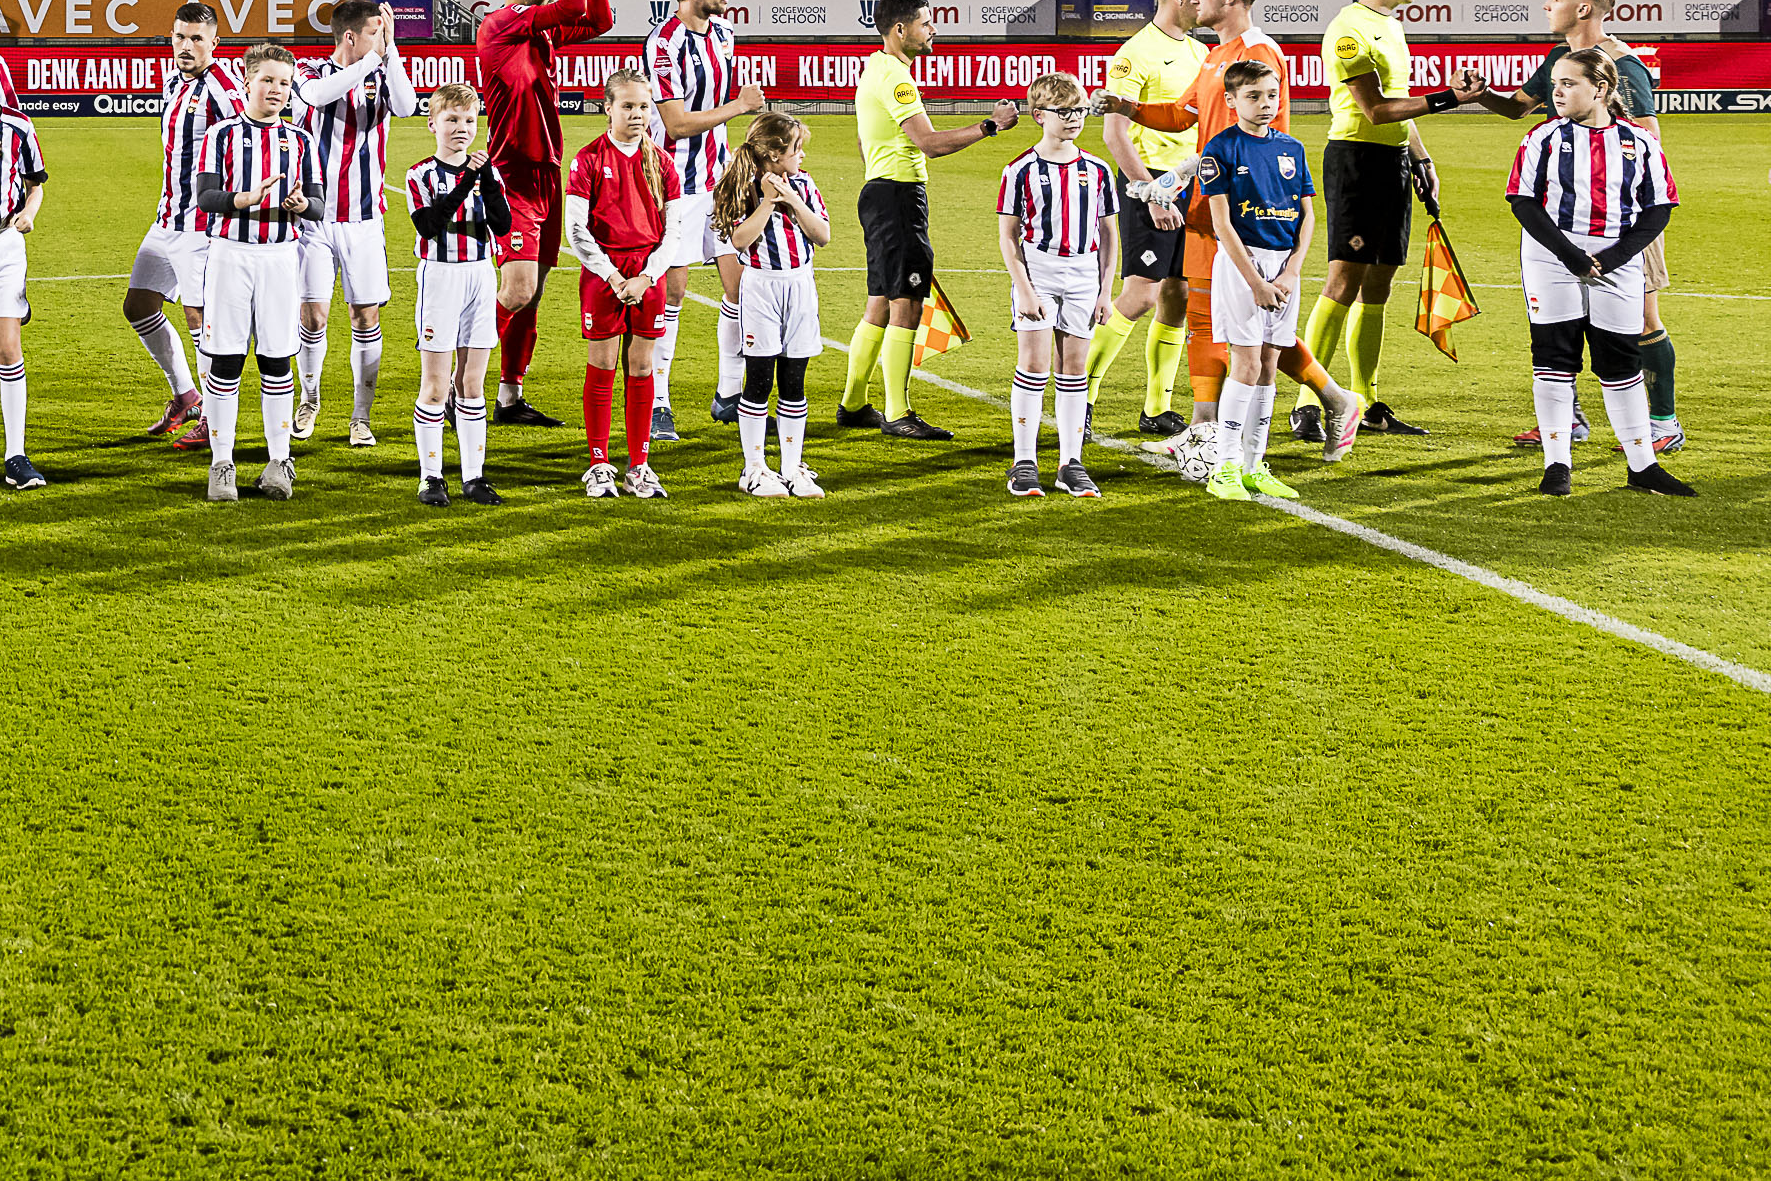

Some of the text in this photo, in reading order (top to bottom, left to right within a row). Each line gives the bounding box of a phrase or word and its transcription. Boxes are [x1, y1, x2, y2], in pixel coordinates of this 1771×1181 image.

[771, 5, 826, 13] ONGEWOON
[981, 5, 1036, 13] ONGEWOON
[1474, 4, 1529, 12] ONGEWOON
[1685, 3, 1740, 11] ONGEWOON
[771, 13, 826, 24] SCHOON
[981, 13, 1036, 24] SCHOON
[1093, 11, 1146, 21] Q-SIGNING.NL
[1264, 12, 1319, 23] SCHOON
[1474, 12, 1529, 22] SCHOON
[1685, 11, 1740, 21] SCHOON
[1337, 43, 1356, 52] ARAG
[27, 58, 81, 90] DENK
[84, 58, 127, 90] AAN
[132, 58, 156, 89] DE
[975, 55, 1001, 86] ZO
[897, 89, 914, 98] ARAG
[52, 102, 80, 113] easy
